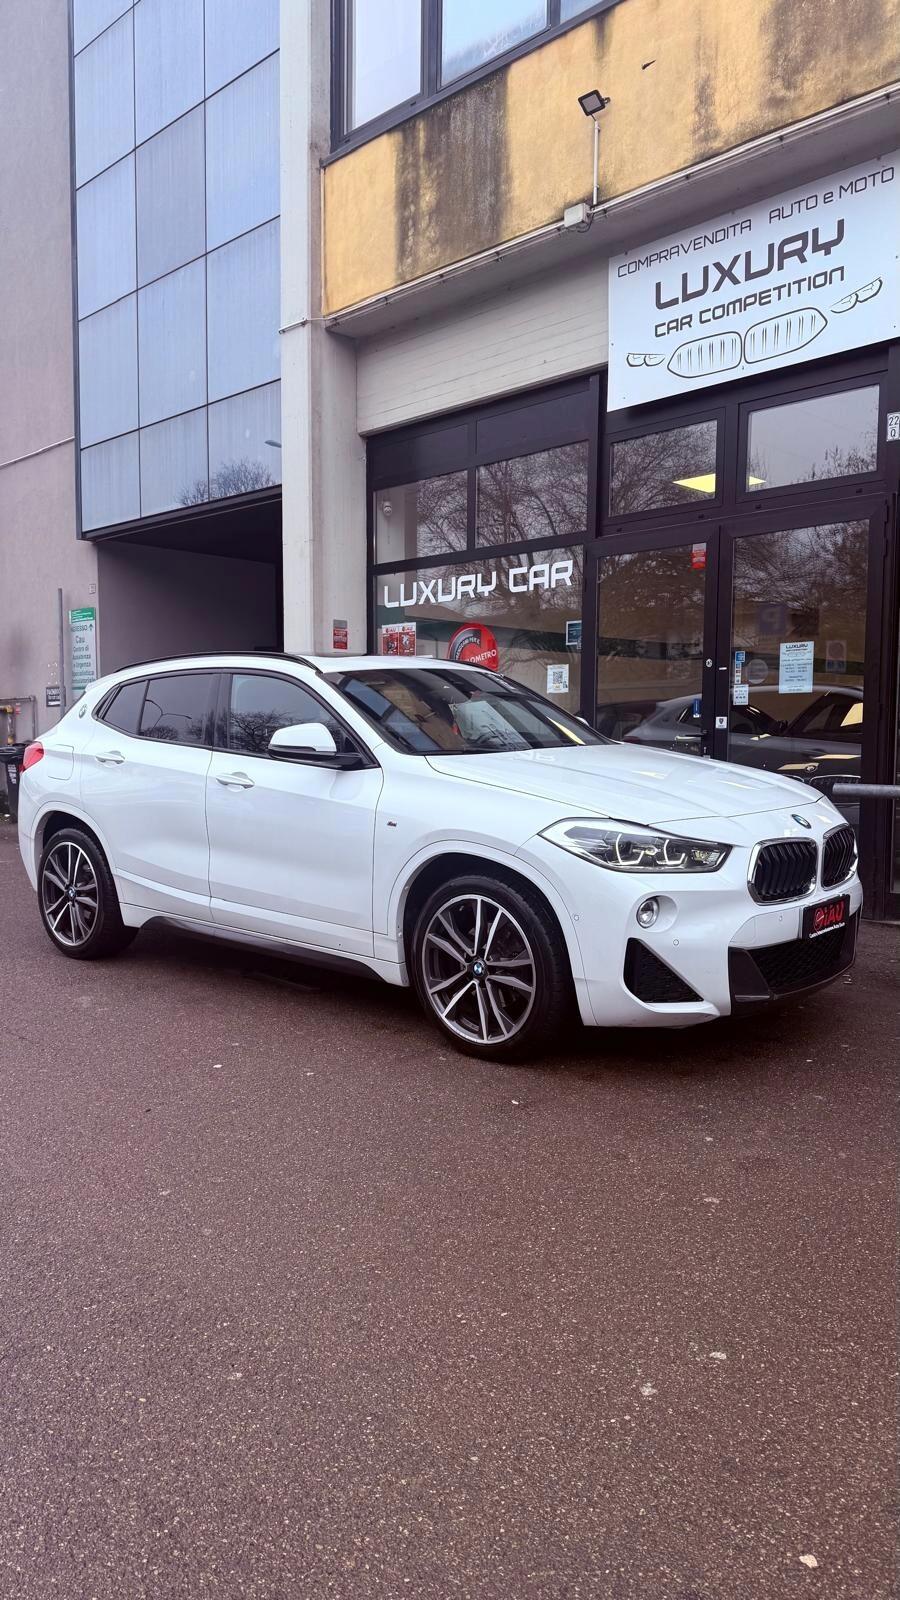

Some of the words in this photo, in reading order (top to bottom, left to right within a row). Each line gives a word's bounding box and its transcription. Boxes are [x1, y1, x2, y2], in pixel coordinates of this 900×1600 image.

[617, 218, 752, 278] COMPRAVENDITA
[769, 194, 818, 224] AUTO
[823, 191, 834, 204] e
[839, 166, 895, 199] MOTO
[655, 218, 845, 310] LUXURY
[655, 313, 693, 338] CAR
[699, 265, 845, 325] COMPETITION
[889, 416, 900, 427] 22
[384, 571, 497, 609] LUXURY
[509, 559, 574, 593] CAR
[466, 649, 497, 663] OMETRO
